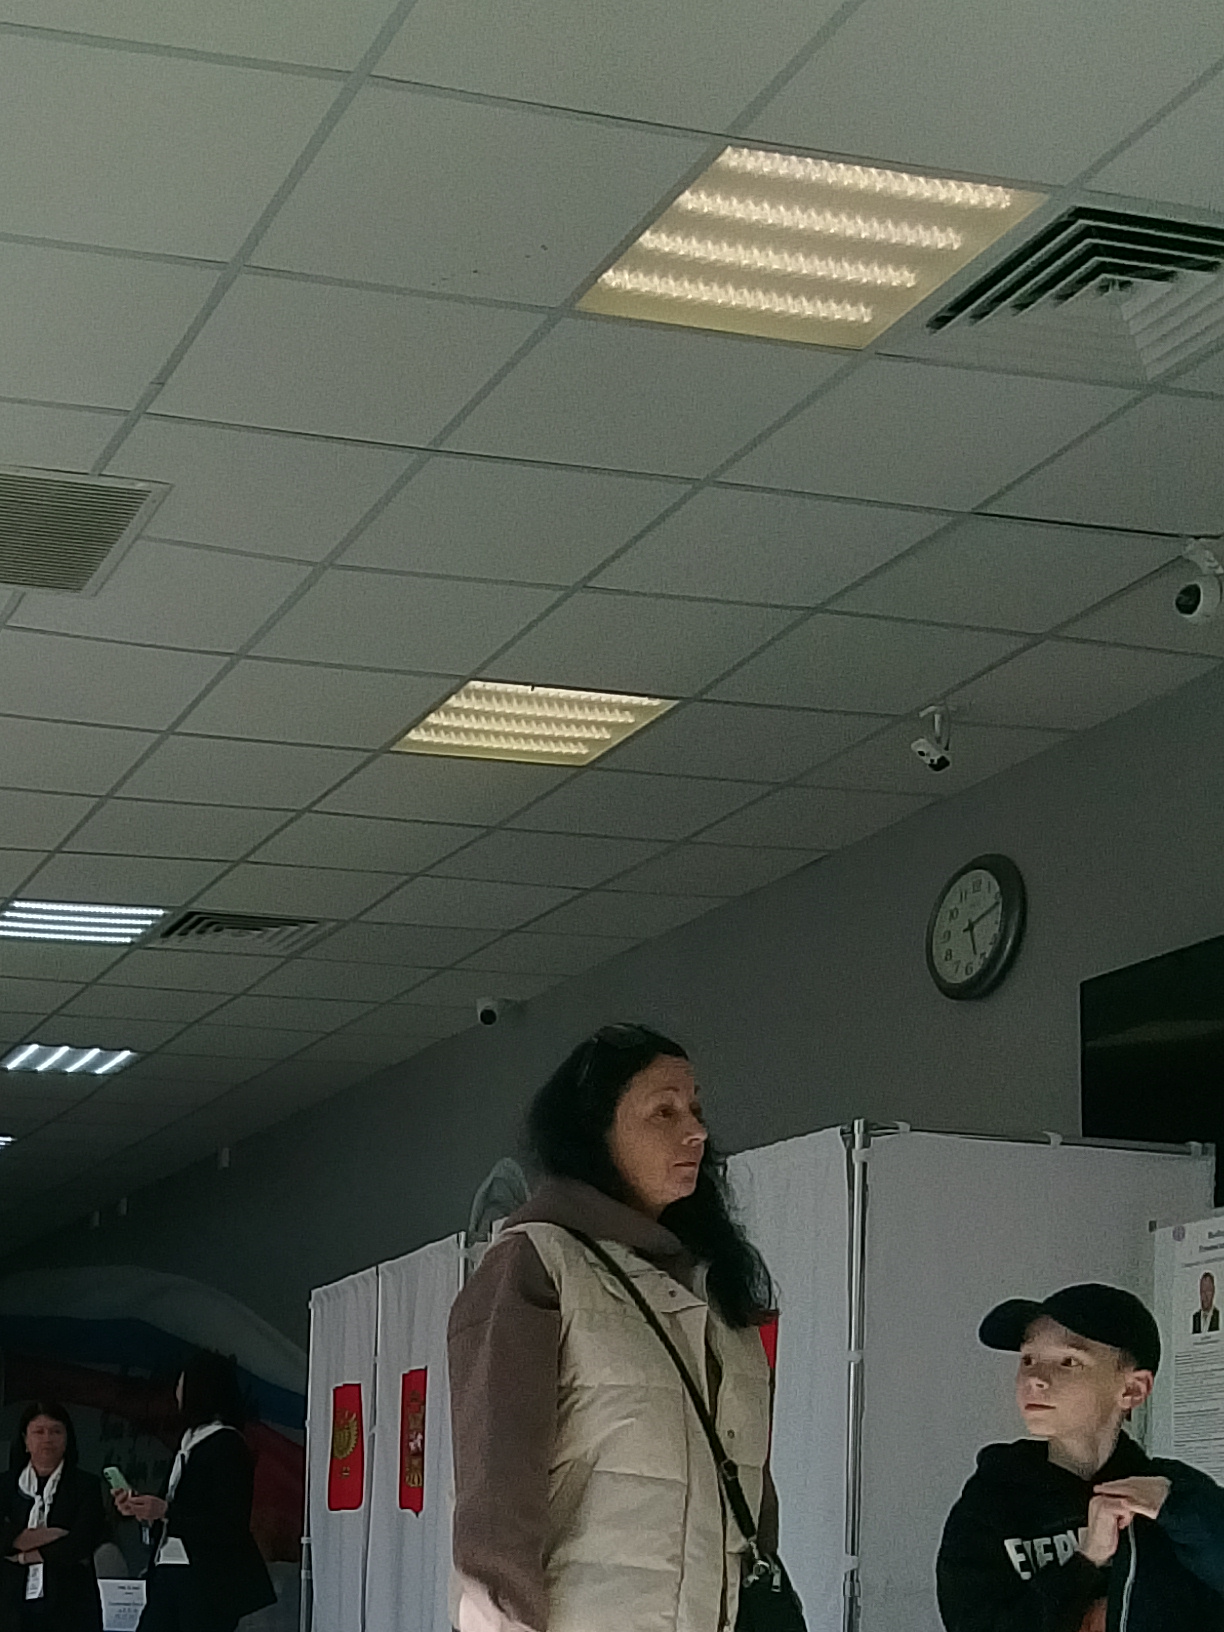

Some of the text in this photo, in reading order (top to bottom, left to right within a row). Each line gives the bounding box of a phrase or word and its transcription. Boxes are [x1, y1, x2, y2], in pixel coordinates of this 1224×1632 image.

[940, 930, 951, 943] 9
[944, 949, 952, 961] 8
[965, 962, 973, 975] 6
